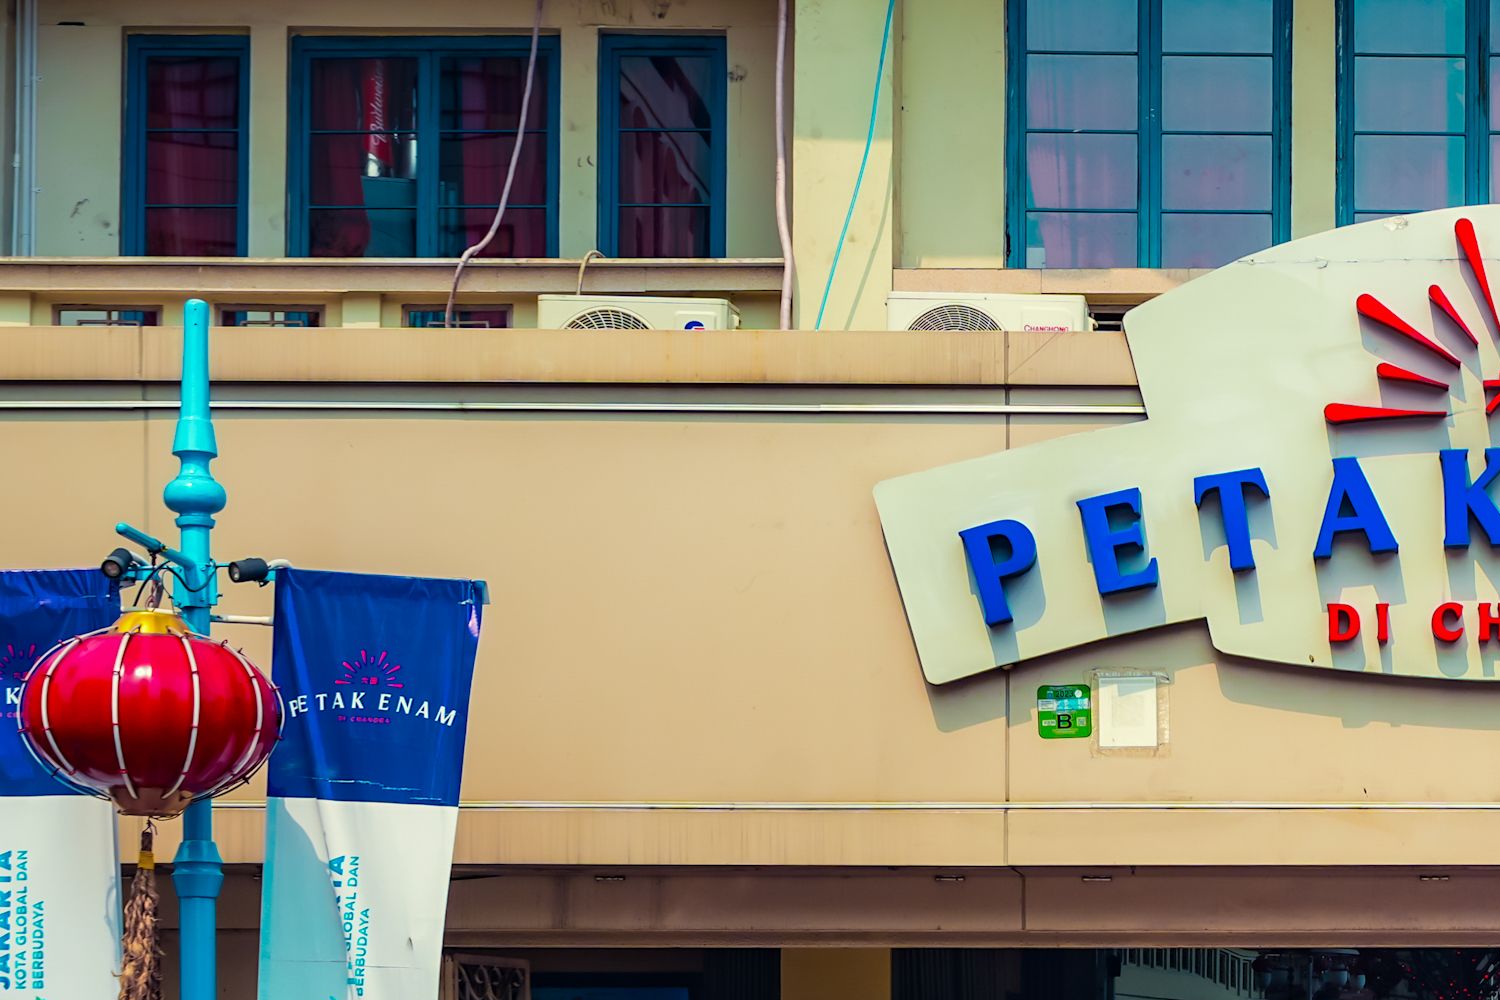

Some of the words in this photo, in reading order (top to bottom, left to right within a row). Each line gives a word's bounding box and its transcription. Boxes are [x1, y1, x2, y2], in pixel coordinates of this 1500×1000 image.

[1327, 602, 1391, 644] DI
[288, 691, 366, 718] PETAK
[377, 693, 457, 727] ENAM
[1057, 713, 1072, 729] B
[16, 850, 28, 881] DAN
[347, 856, 359, 887] DAN
[15, 886, 28, 946] GLOBAL
[32, 900, 45, 990] BERBUDAYA
[15, 950, 27, 990] KOTA
